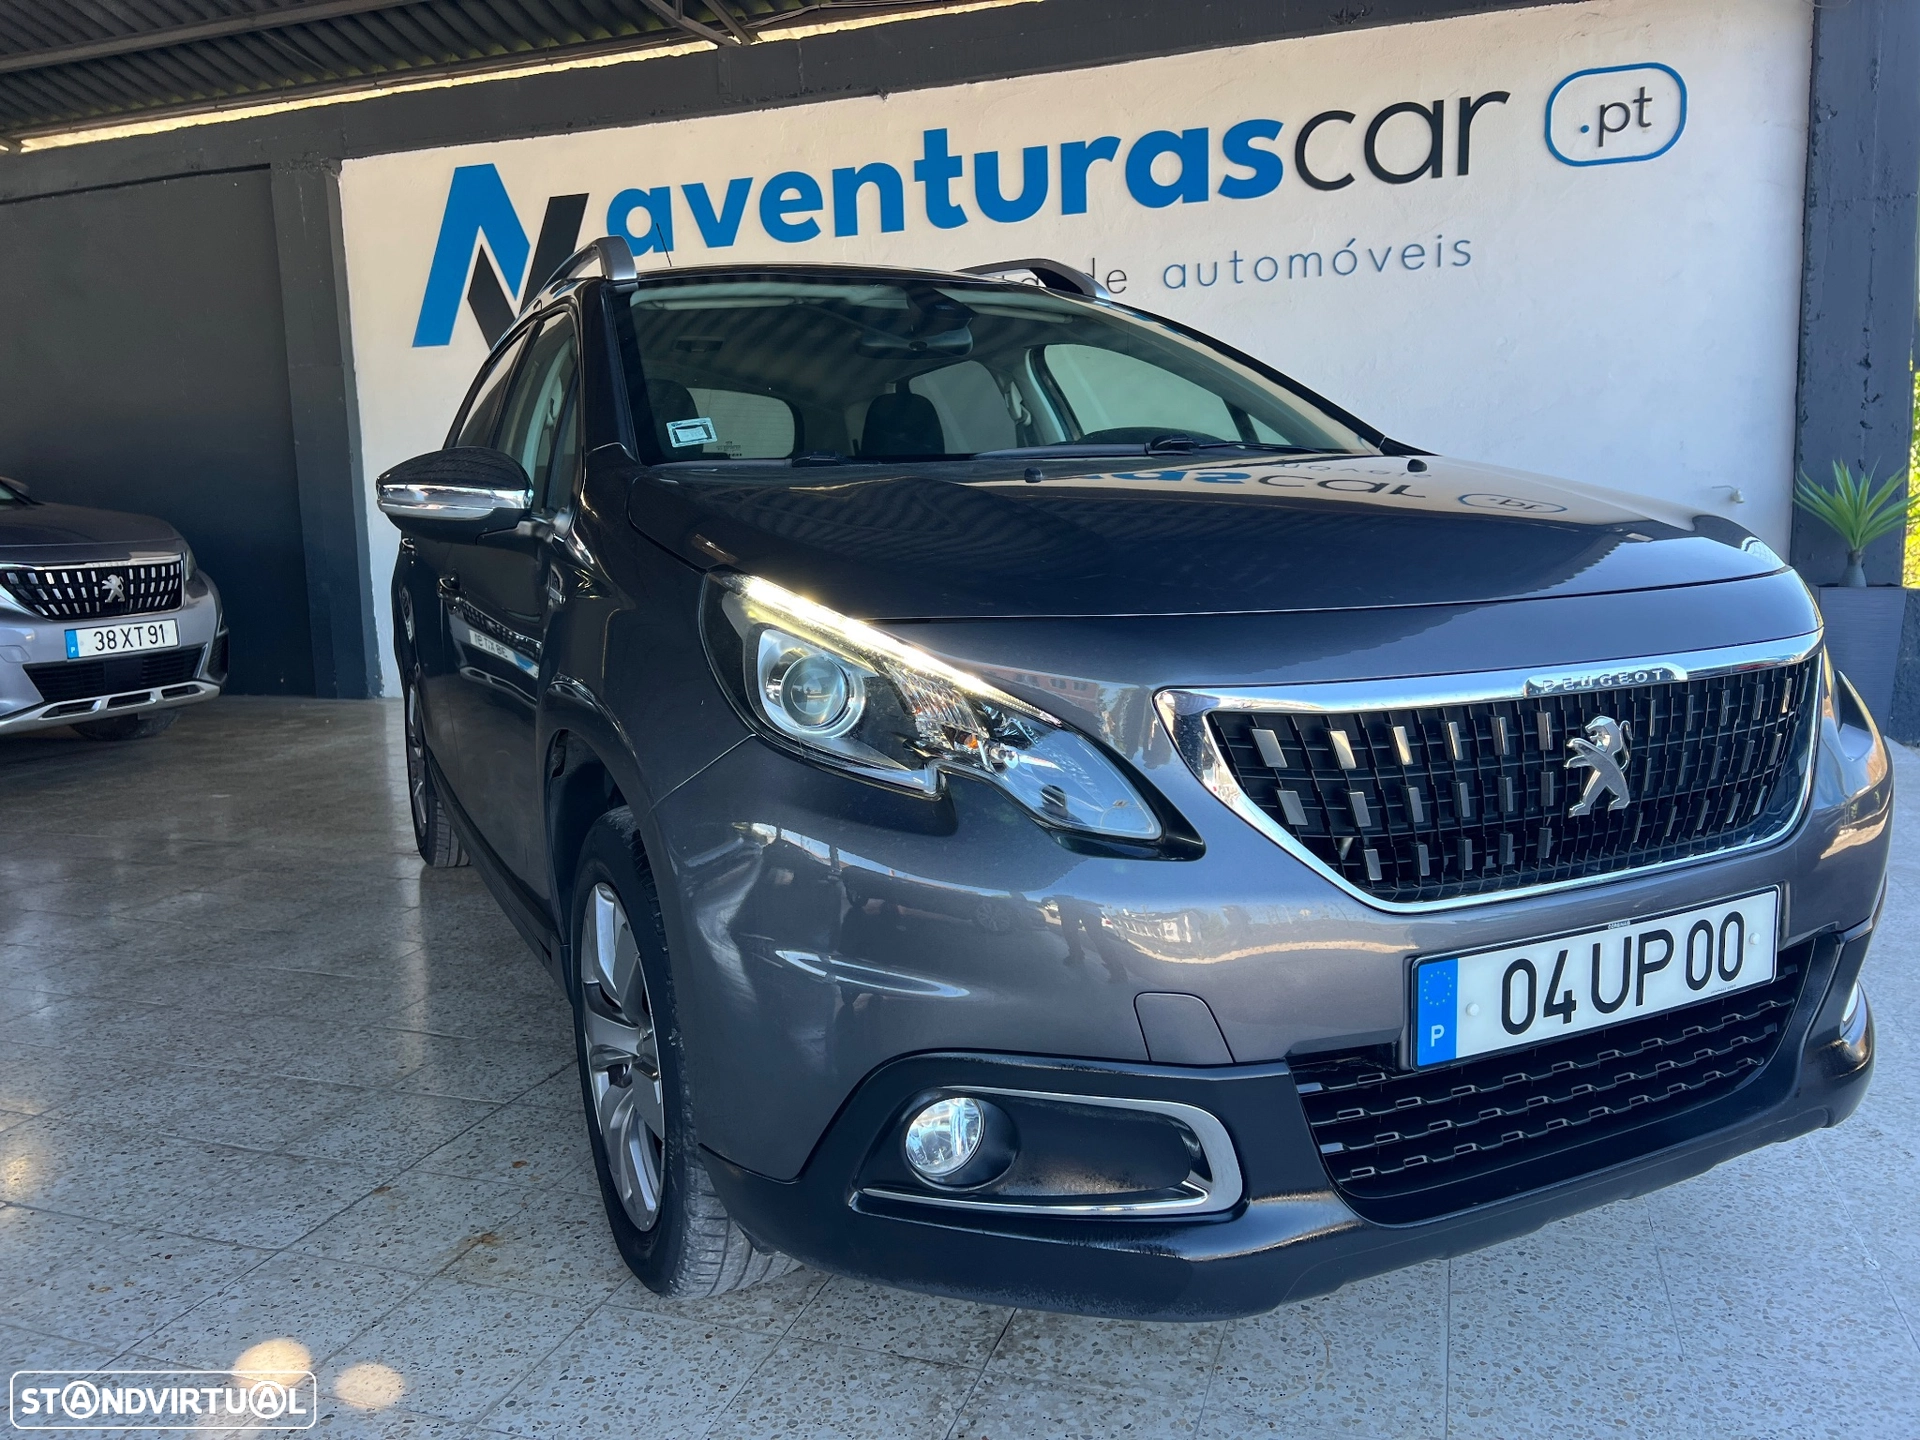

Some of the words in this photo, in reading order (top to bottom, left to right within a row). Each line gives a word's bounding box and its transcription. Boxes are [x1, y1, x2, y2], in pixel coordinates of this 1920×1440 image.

[606, 90, 1510, 257] aventurascar
[1162, 234, 1472, 291] automóveis
[1542, 667, 1663, 693] PEUGEOT
[1430, 1024, 1444, 1047] P
